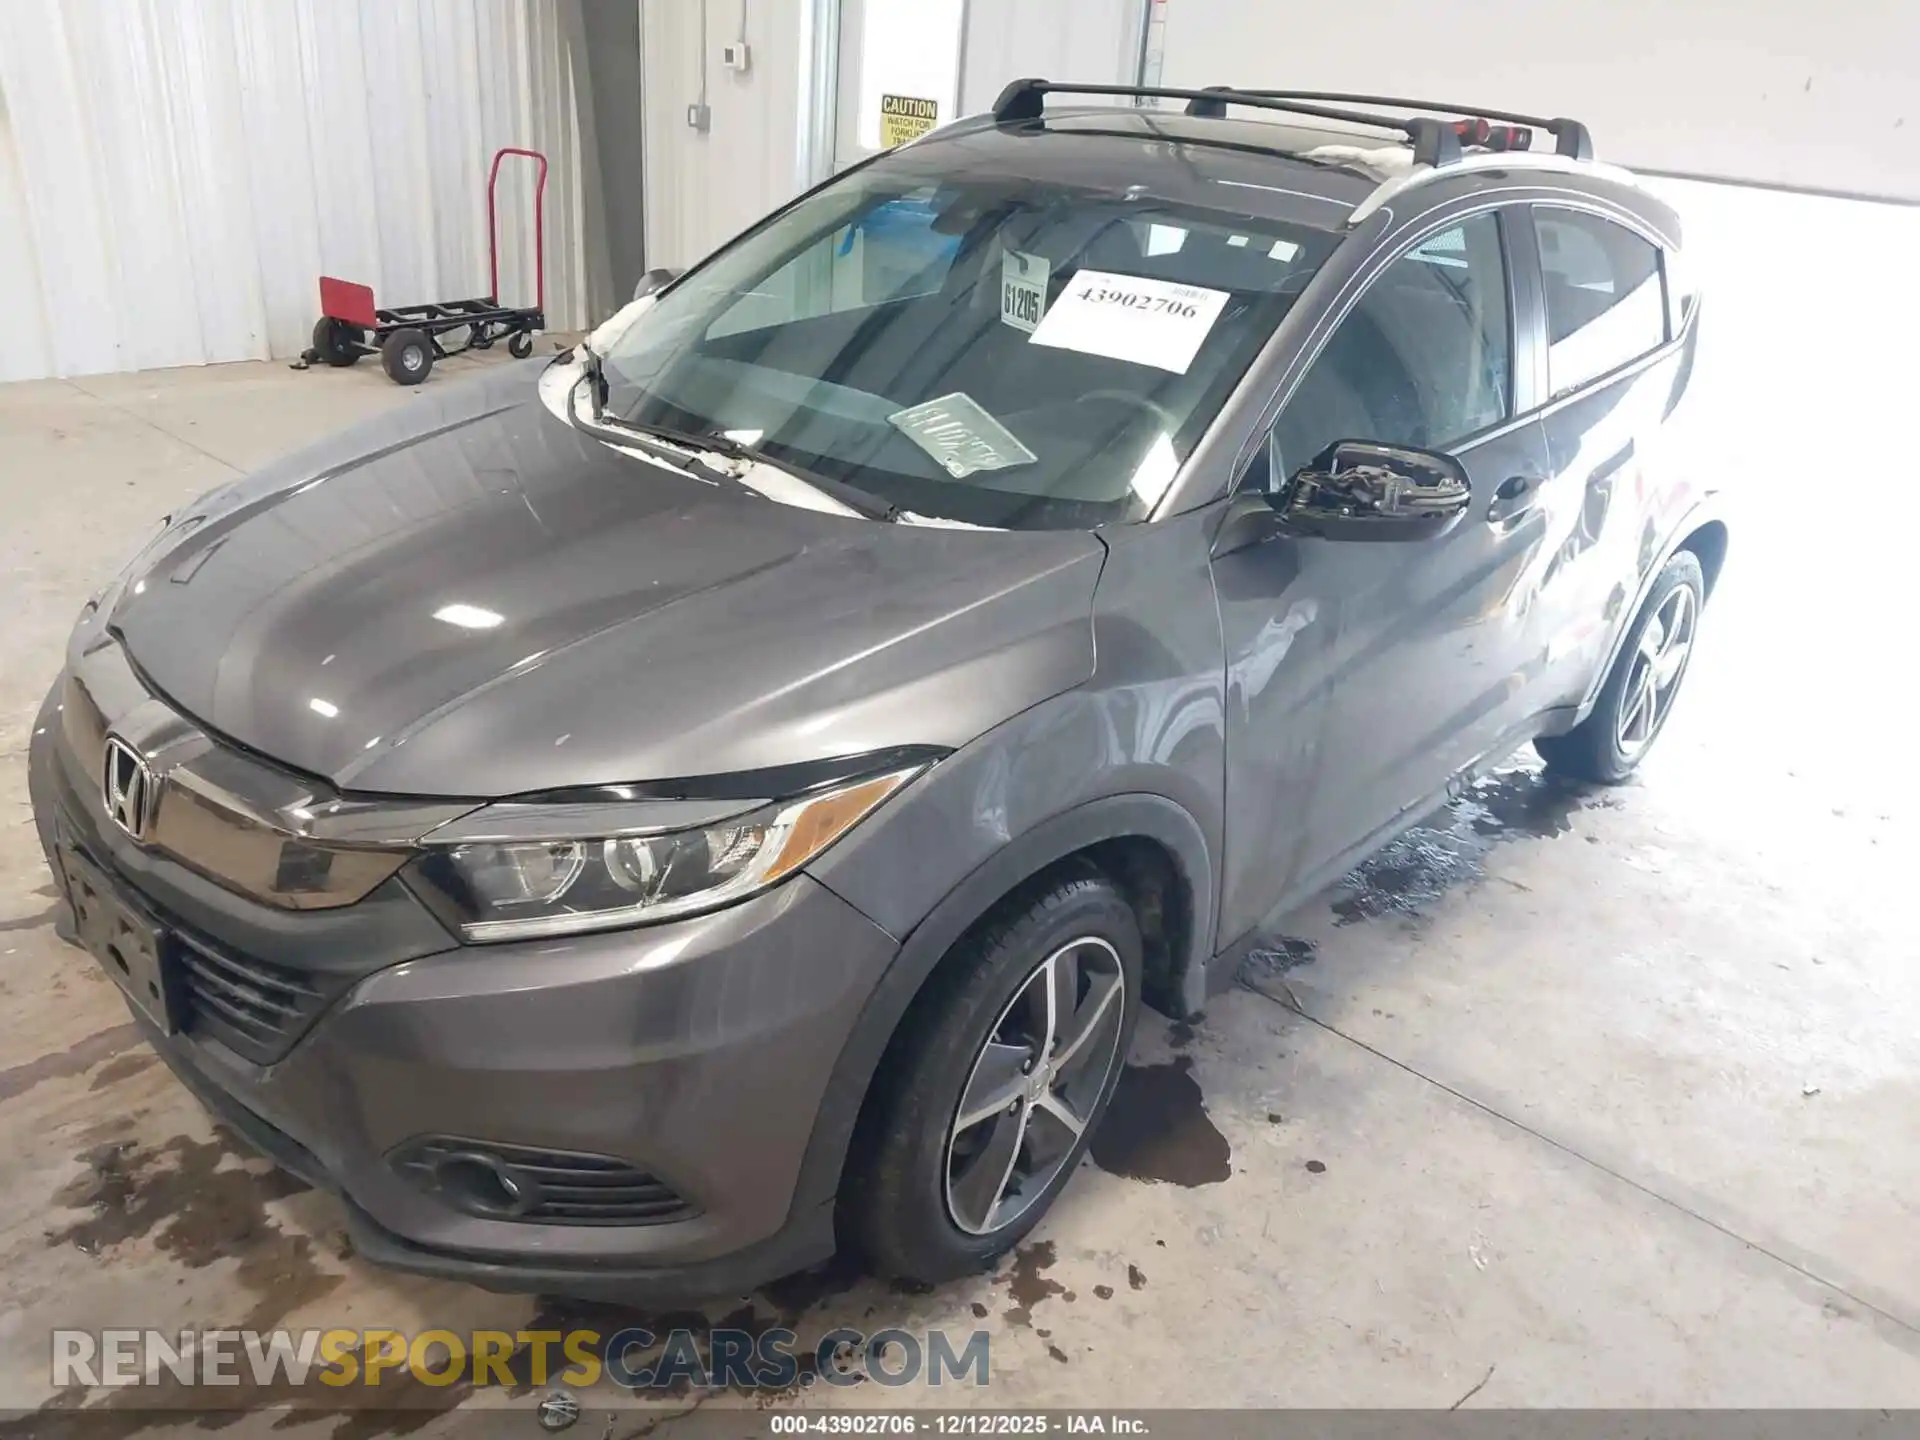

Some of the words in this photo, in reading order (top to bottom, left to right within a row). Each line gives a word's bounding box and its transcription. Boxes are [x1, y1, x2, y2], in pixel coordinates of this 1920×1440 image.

[884, 96, 936, 118] CAUTION
[915, 119, 930, 129] FOR
[1077, 287, 1197, 319] 43902706
